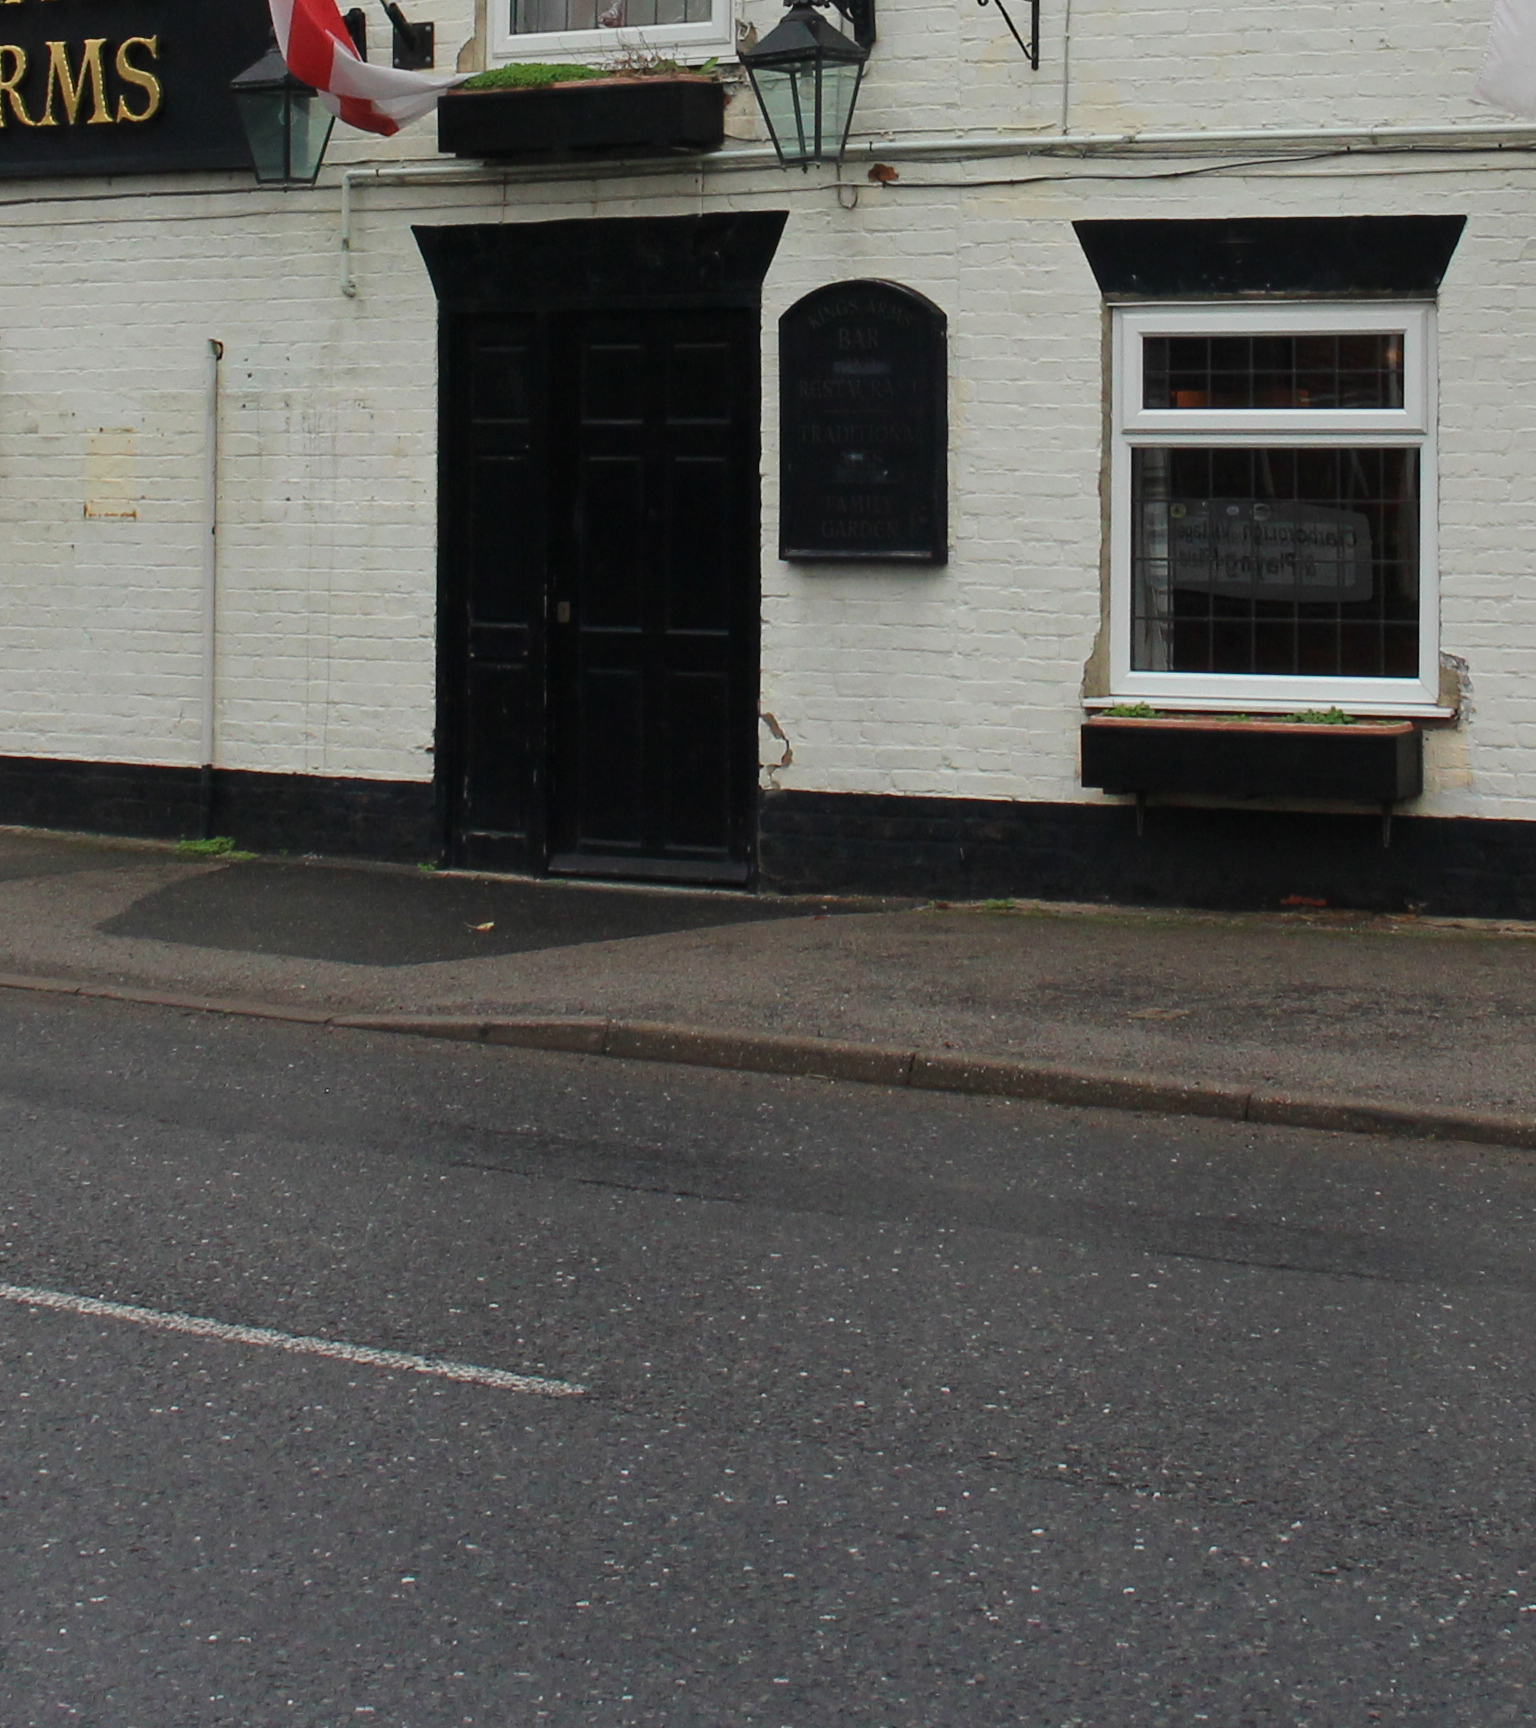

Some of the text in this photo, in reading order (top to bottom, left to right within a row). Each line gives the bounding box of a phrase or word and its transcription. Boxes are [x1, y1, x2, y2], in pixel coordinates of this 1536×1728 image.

[807, 298, 912, 330] KINGS ARMS
[838, 327, 879, 350] BAR
[825, 495, 894, 514] FAMILY
[820, 520, 899, 539] GARDEN
